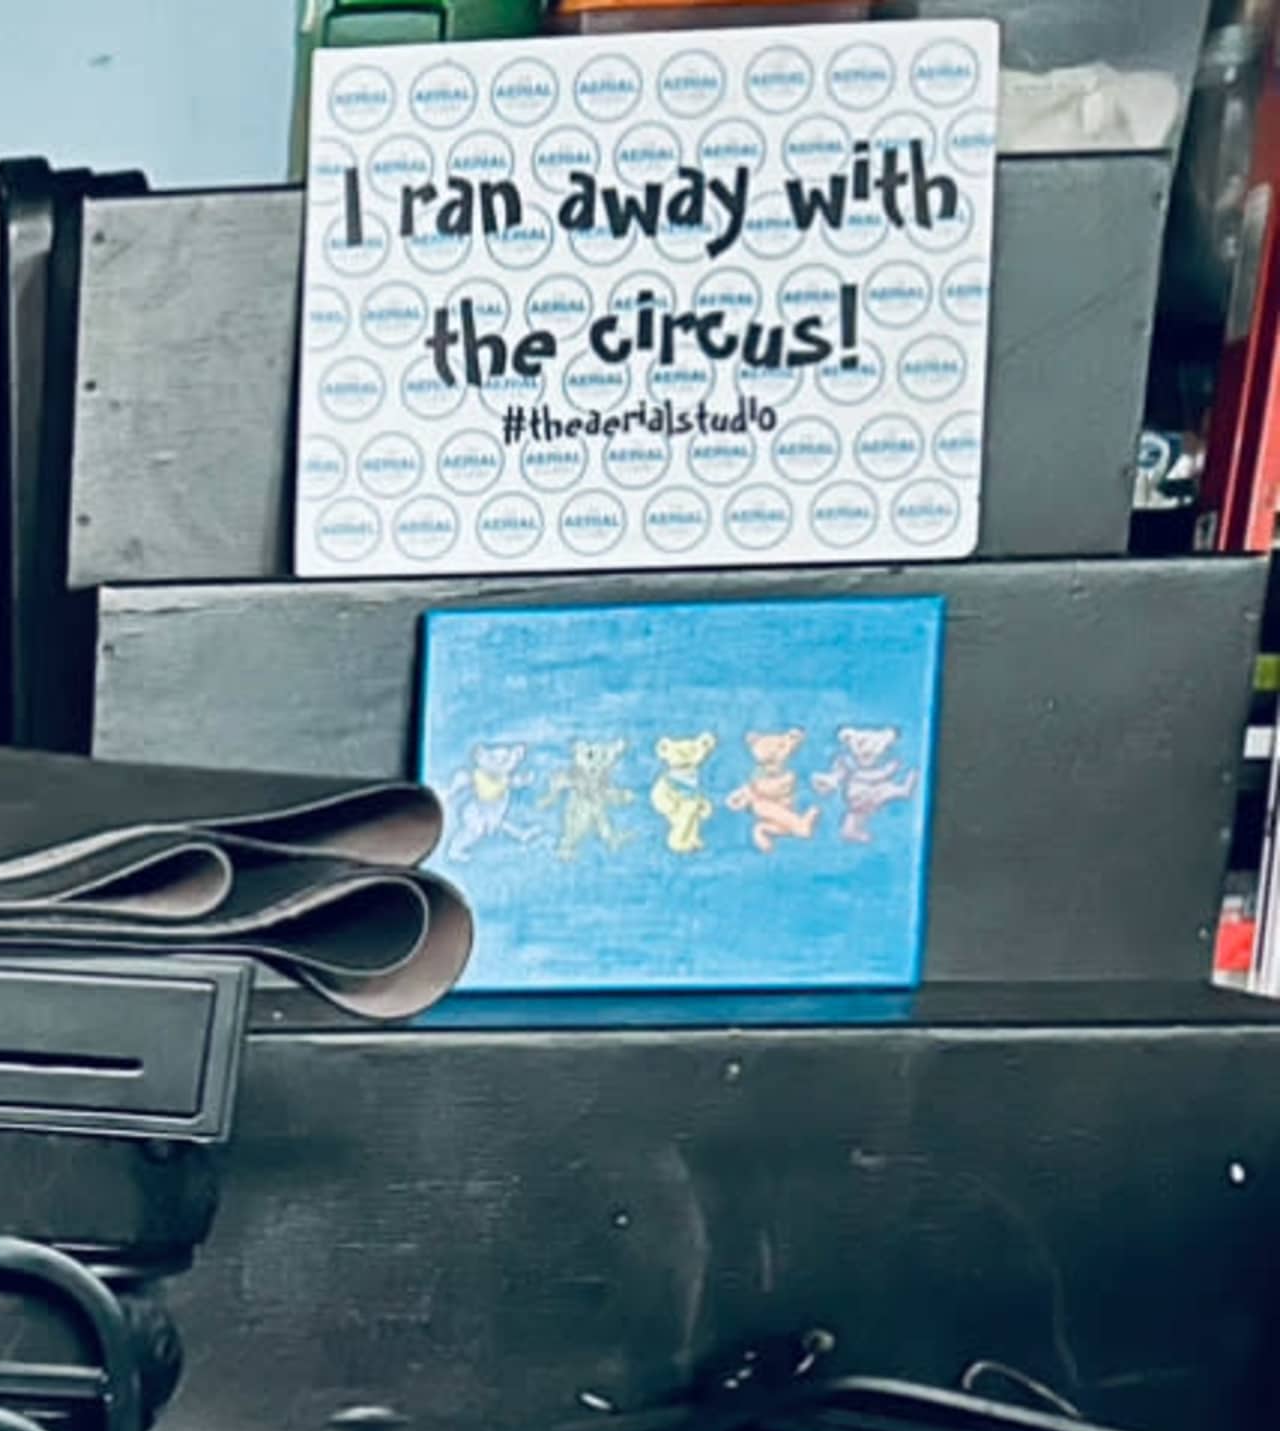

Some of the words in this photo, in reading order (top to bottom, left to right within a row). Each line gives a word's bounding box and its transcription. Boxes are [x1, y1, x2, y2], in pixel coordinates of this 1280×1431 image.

[345, 167, 363, 246] I
[400, 177, 523, 237] ran
[558, 166, 749, 258] away
[785, 139, 958, 229] with
[426, 298, 557, 387] the
[589, 284, 858, 370] circus!
[502, 398, 777, 445] #theaerialstudio
